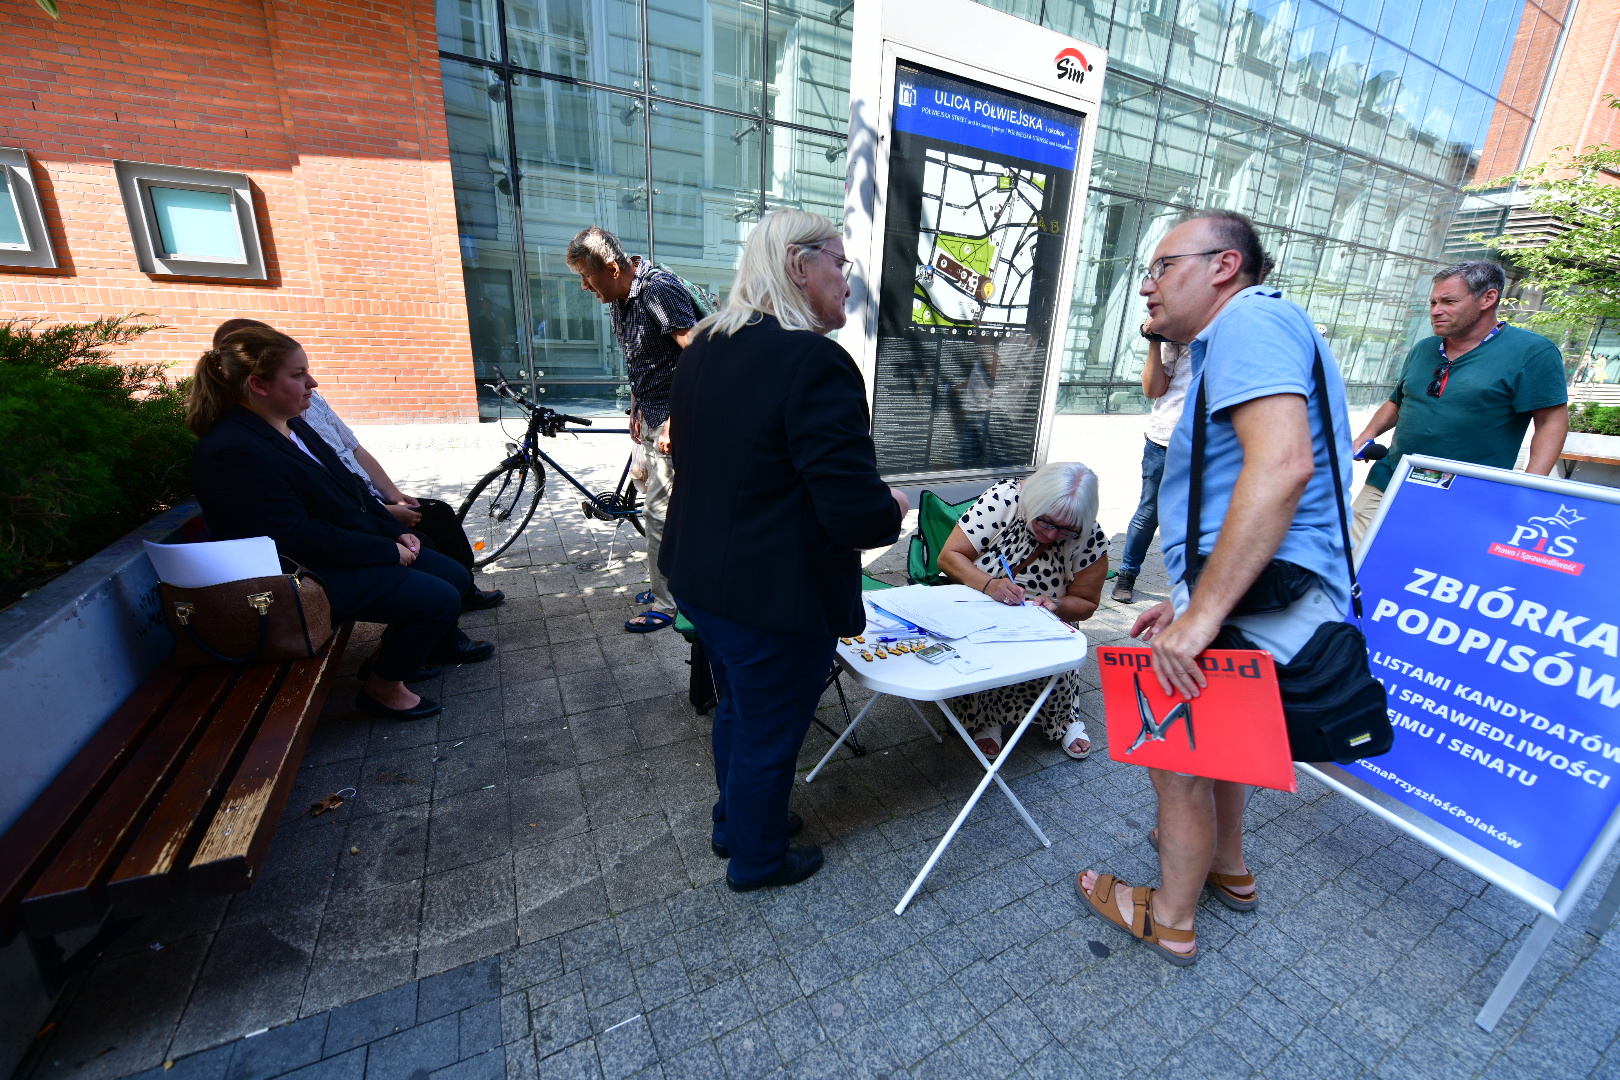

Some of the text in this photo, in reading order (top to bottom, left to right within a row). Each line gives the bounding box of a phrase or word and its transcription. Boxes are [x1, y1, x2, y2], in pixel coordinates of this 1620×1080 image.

[934, 89, 971, 112] ULICA
[974, 100, 1043, 131] PÓŁWIEJSKA
[1057, 58, 1084, 84] Sim
[951, 114, 968, 123] STREET
[1494, 545, 1516, 556] Prawo
[1520, 552, 1577, 571] Sprawiedliwość
[1507, 524, 1578, 557] PiS
[1404, 568, 1619, 657] ZBIÓRKA
[1371, 598, 1620, 709] PODPISÓW
[1372, 651, 1620, 764] LISTAMI KANDYDATÓW
[1388, 684, 1611, 790] I SPRAWIEDLIWOŚCI
[1386, 708, 1538, 786] EJMU I SENATU
[1355, 758, 1522, 849] ecznaPrzyszłośćPolaków
